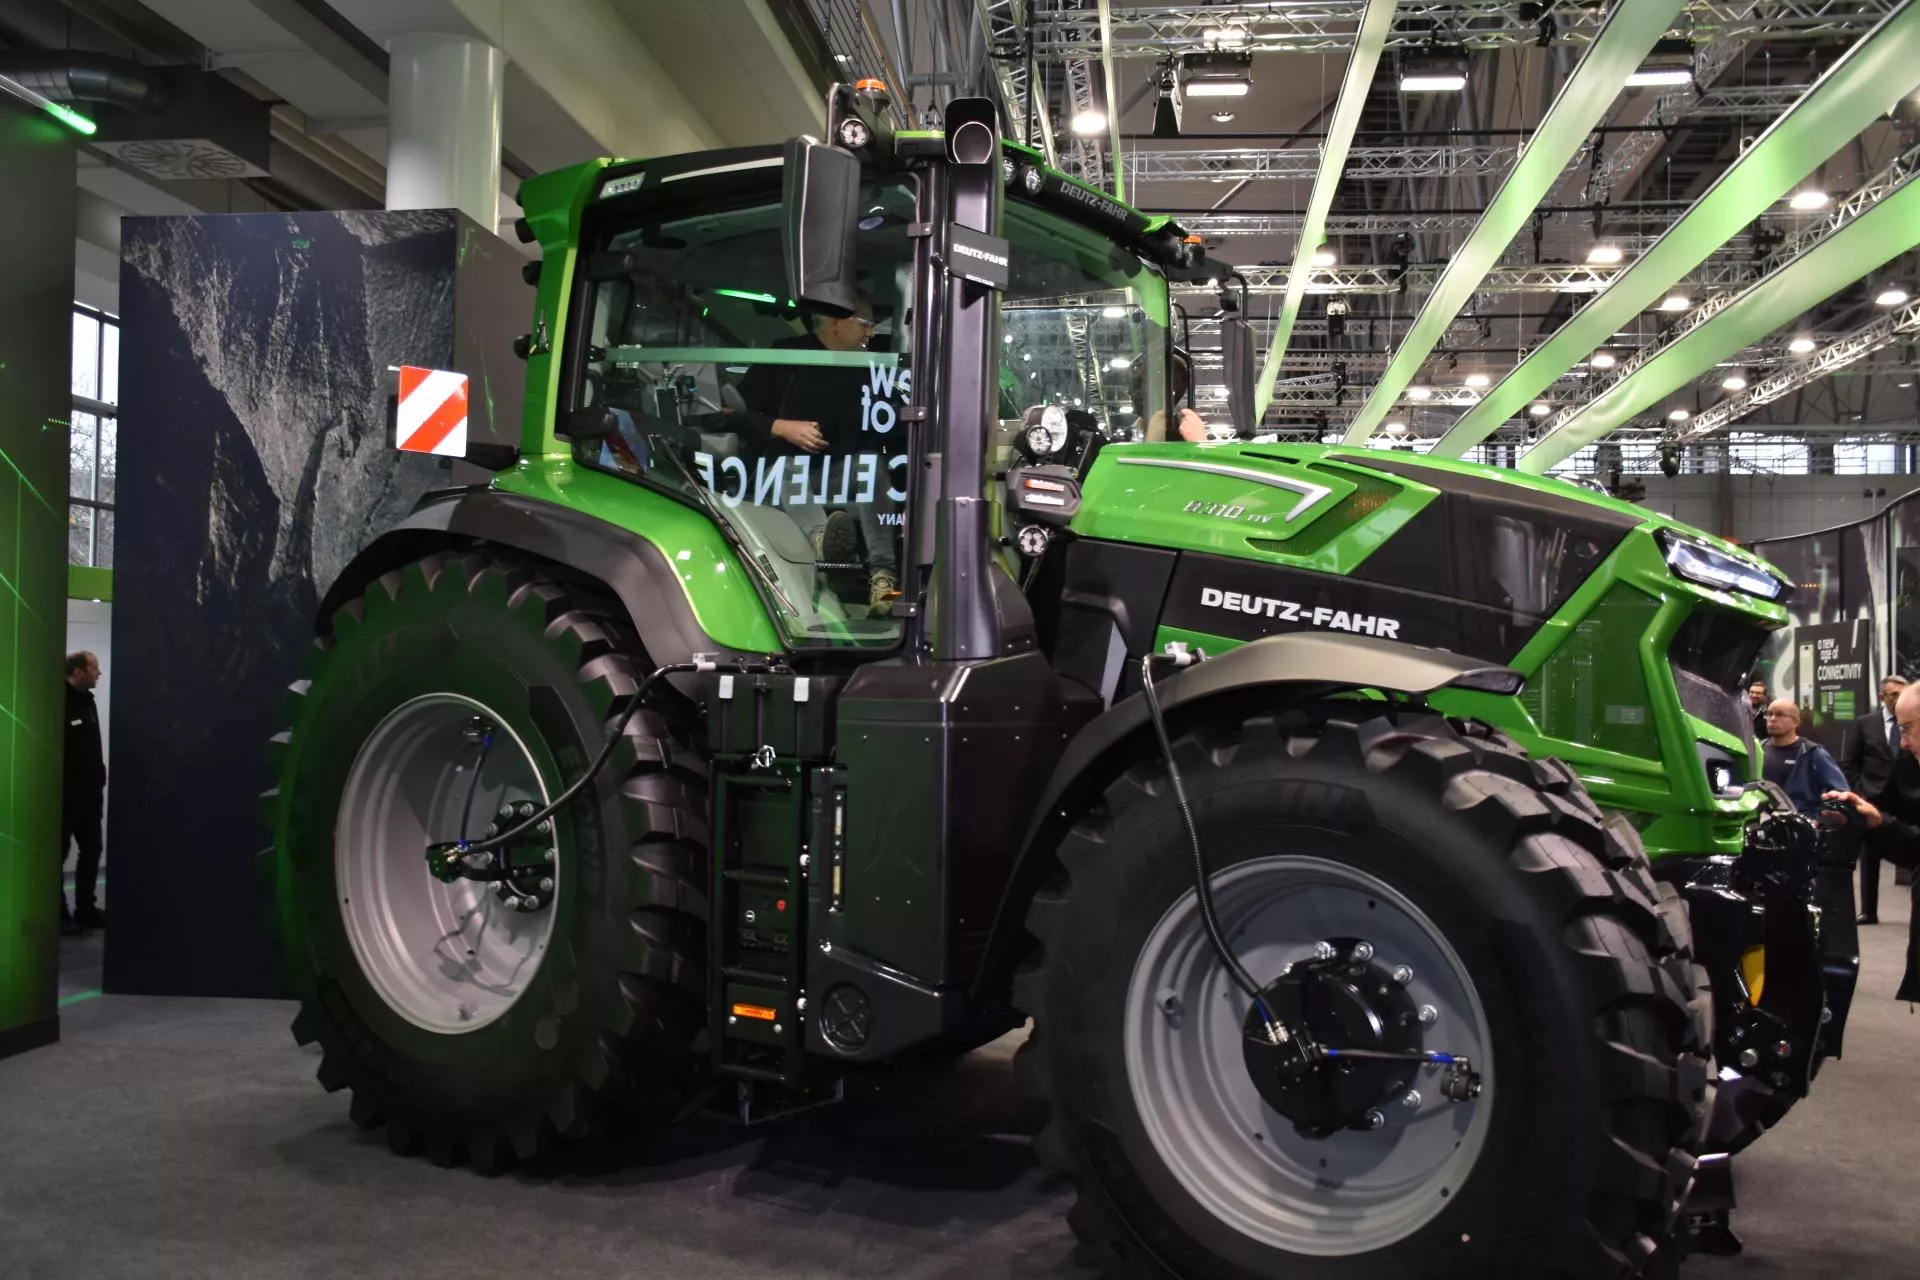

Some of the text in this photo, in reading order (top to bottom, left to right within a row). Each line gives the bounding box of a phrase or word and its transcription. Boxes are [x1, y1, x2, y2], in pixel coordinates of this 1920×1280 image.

[1060, 181, 1128, 222] DEUTZ-FAHR
[953, 243, 1008, 267] DEUTZ-FAHR
[1201, 588, 1400, 639] DEUTZ-FAHR
[1822, 638, 1835, 649] new
[1820, 649, 1832, 663] age
[1817, 663, 1862, 681] CONNECTIVITY
